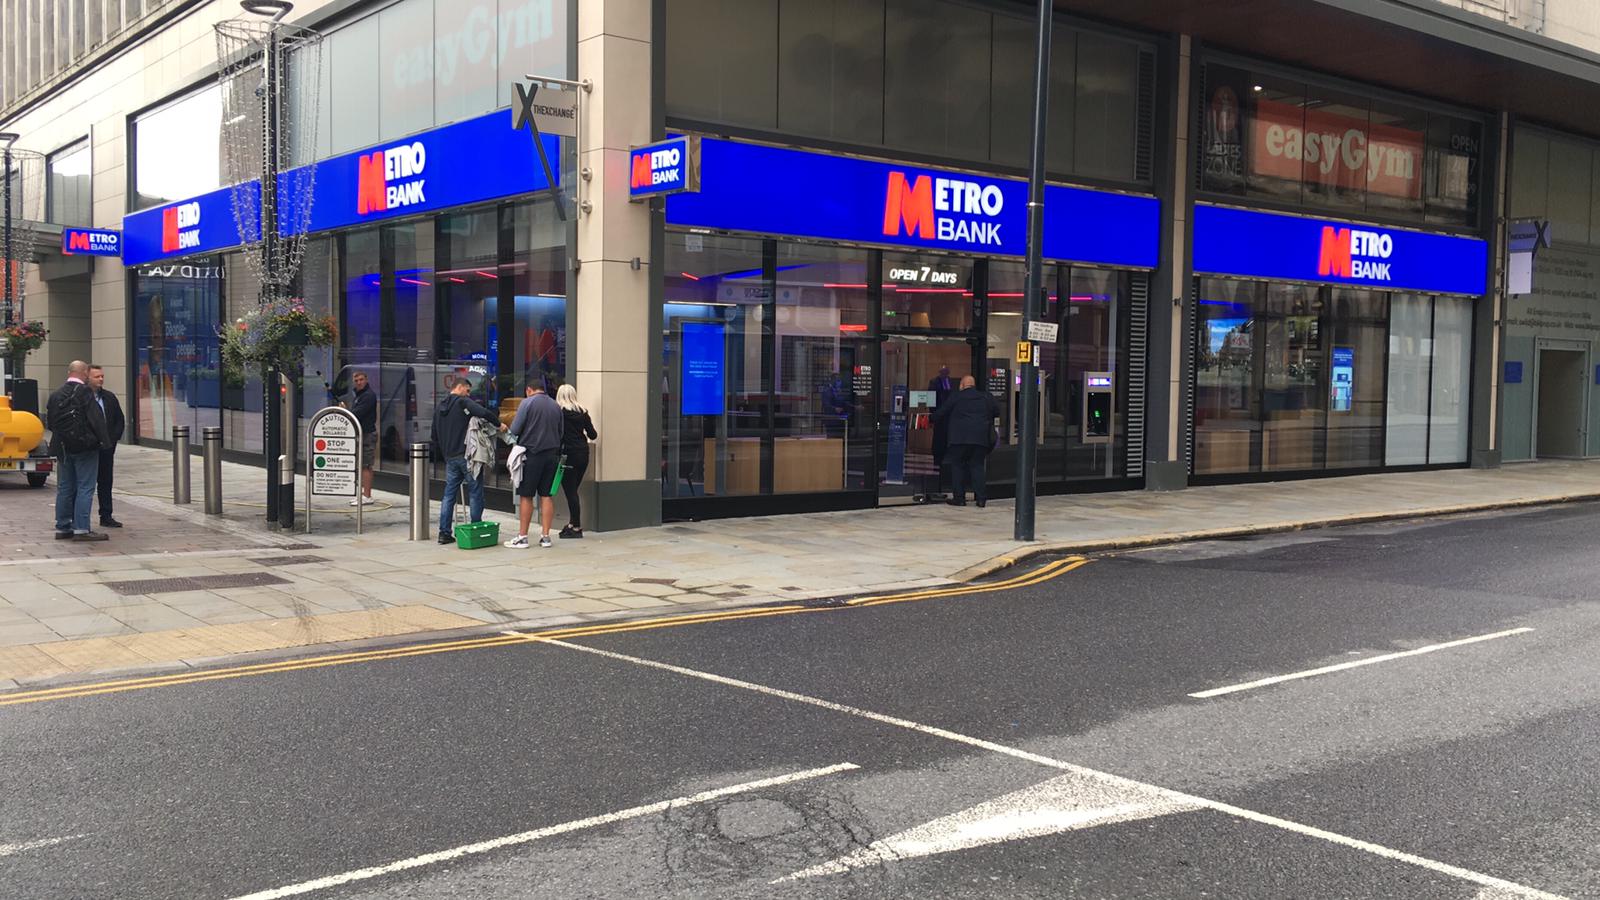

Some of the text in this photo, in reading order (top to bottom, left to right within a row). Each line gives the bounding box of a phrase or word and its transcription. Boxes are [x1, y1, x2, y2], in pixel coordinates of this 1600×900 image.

[534, 104, 576, 119] THEXCHANGE
[1265, 122, 1414, 181] easyGym
[357, 141, 426, 215] METRO
[631, 147, 680, 189] METRO
[652, 168, 680, 185] BANK
[386, 179, 426, 209] BANK
[883, 171, 1004, 240] METRO
[162, 201, 200, 253] METRO
[937, 217, 1002, 246] BANK
[69, 231, 118, 252] METRO
[90, 243, 118, 253] BANK
[178, 228, 200, 250] BANK
[1318, 225, 1394, 278] METRO
[889, 266, 958, 285] OPEN 7 DAYS
[1351, 260, 1392, 281] BANK
[1018, 343, 1029, 359] H
[320, 415, 350, 427] CAUTION
